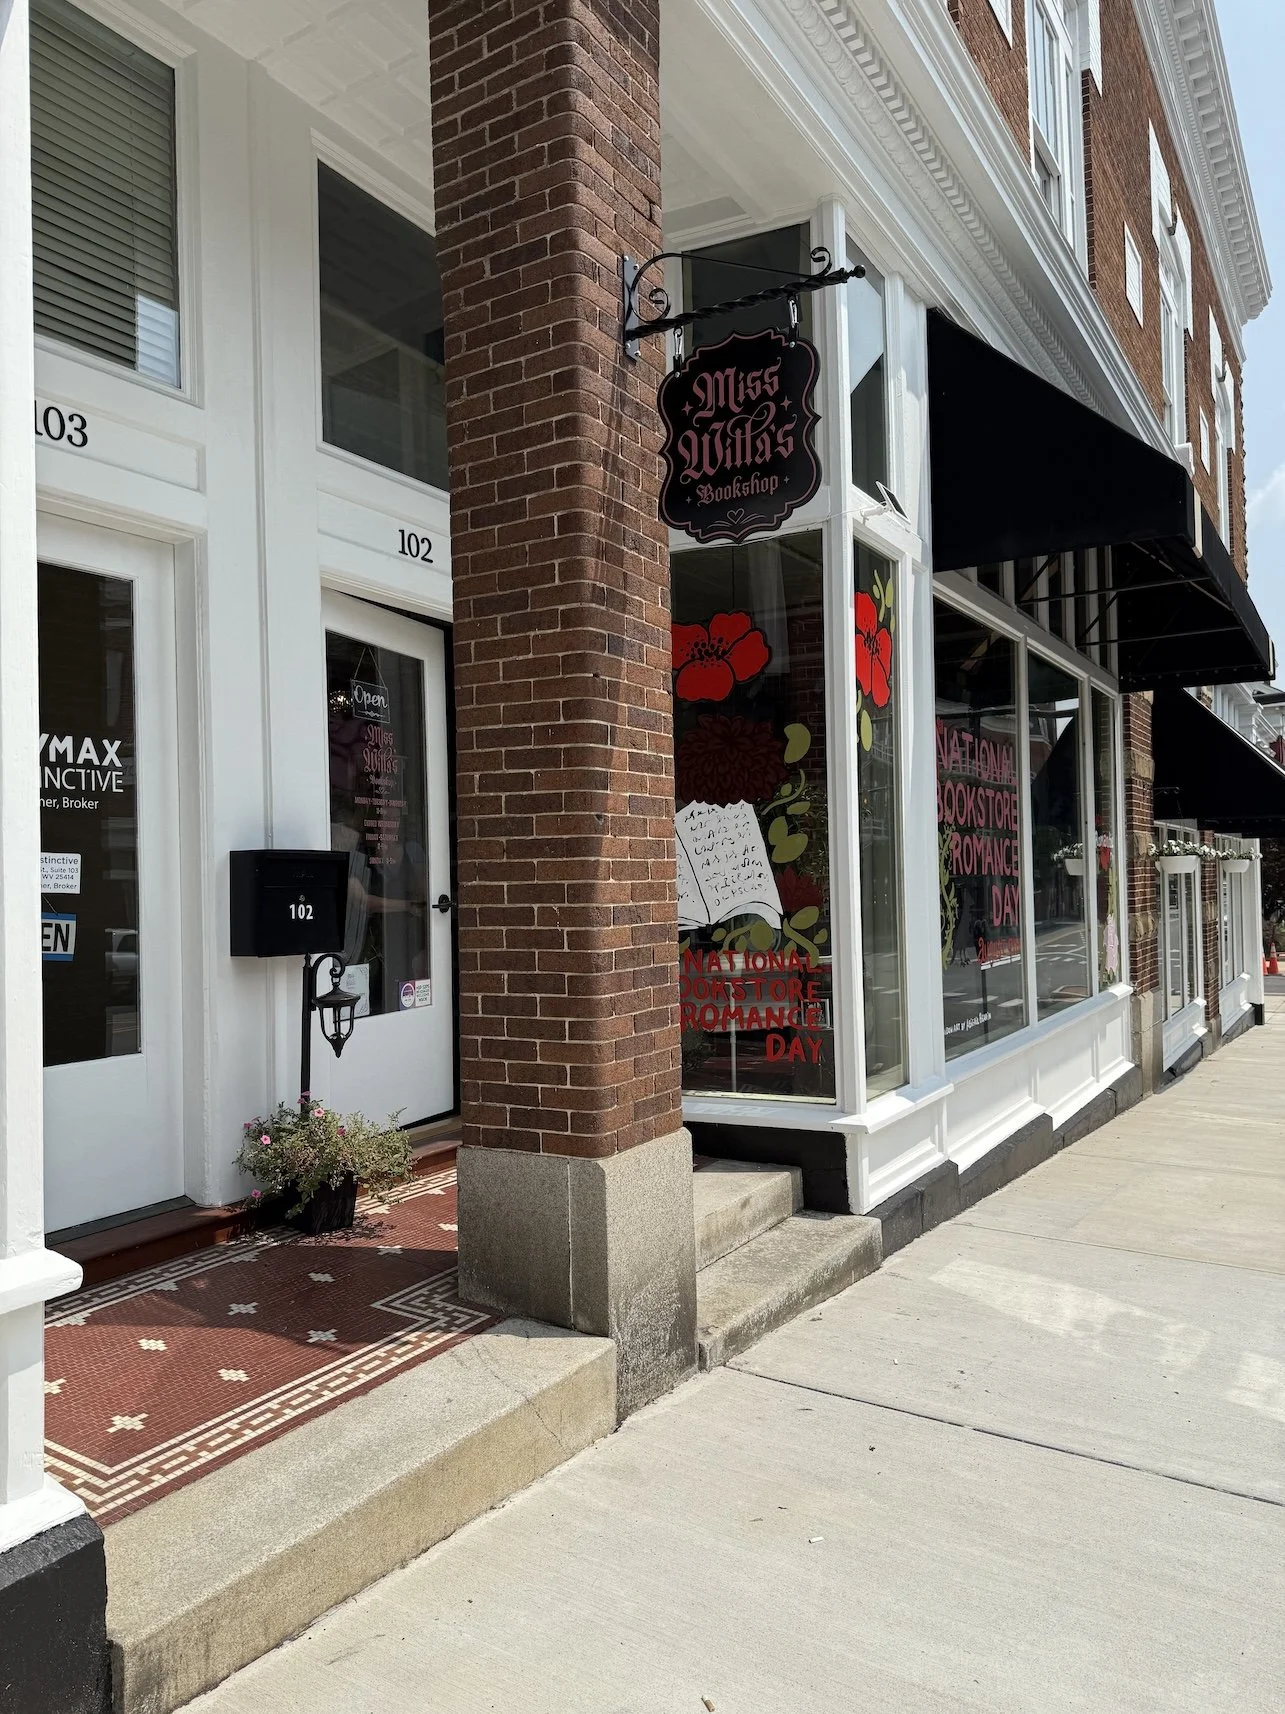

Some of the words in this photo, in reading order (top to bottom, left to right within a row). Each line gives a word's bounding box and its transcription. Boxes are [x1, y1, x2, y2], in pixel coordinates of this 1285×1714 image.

[692, 357, 782, 428] Miss
[677, 401, 798, 485] Willa's
[695, 472, 779, 507] Bookshop
[398, 529, 434, 564] 102
[354, 684, 388, 710] Open
[366, 723, 394, 749] Miss
[936, 727, 1018, 787] NATIONAL
[62, 796, 100, 810] Broker
[951, 831, 1019, 878] ROMANCE
[53, 882, 78, 890] Broker
[289, 903, 314, 920] 102
[992, 884, 1019, 927] DAY
[41, 922, 70, 952] EN
[683, 948, 824, 974] NATIONAL
[680, 1002, 823, 1033] ROMANCE
[765, 1033, 823, 1065] DAY
